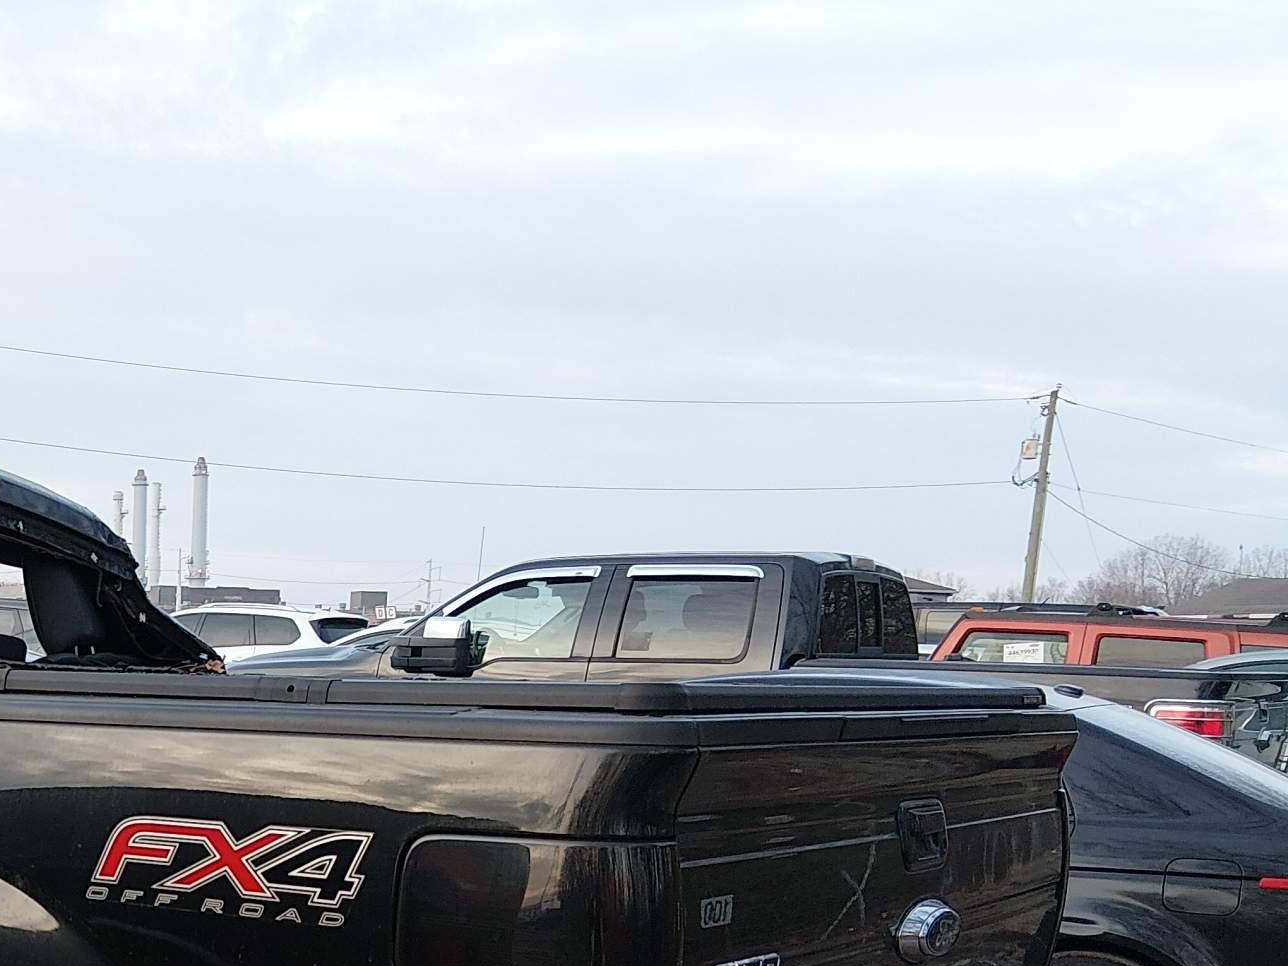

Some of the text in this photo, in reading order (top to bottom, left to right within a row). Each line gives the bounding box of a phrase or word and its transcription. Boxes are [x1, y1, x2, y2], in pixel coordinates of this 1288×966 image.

[91, 815, 374, 908] FX4
[85, 885, 345, 927] OFF ROAD
